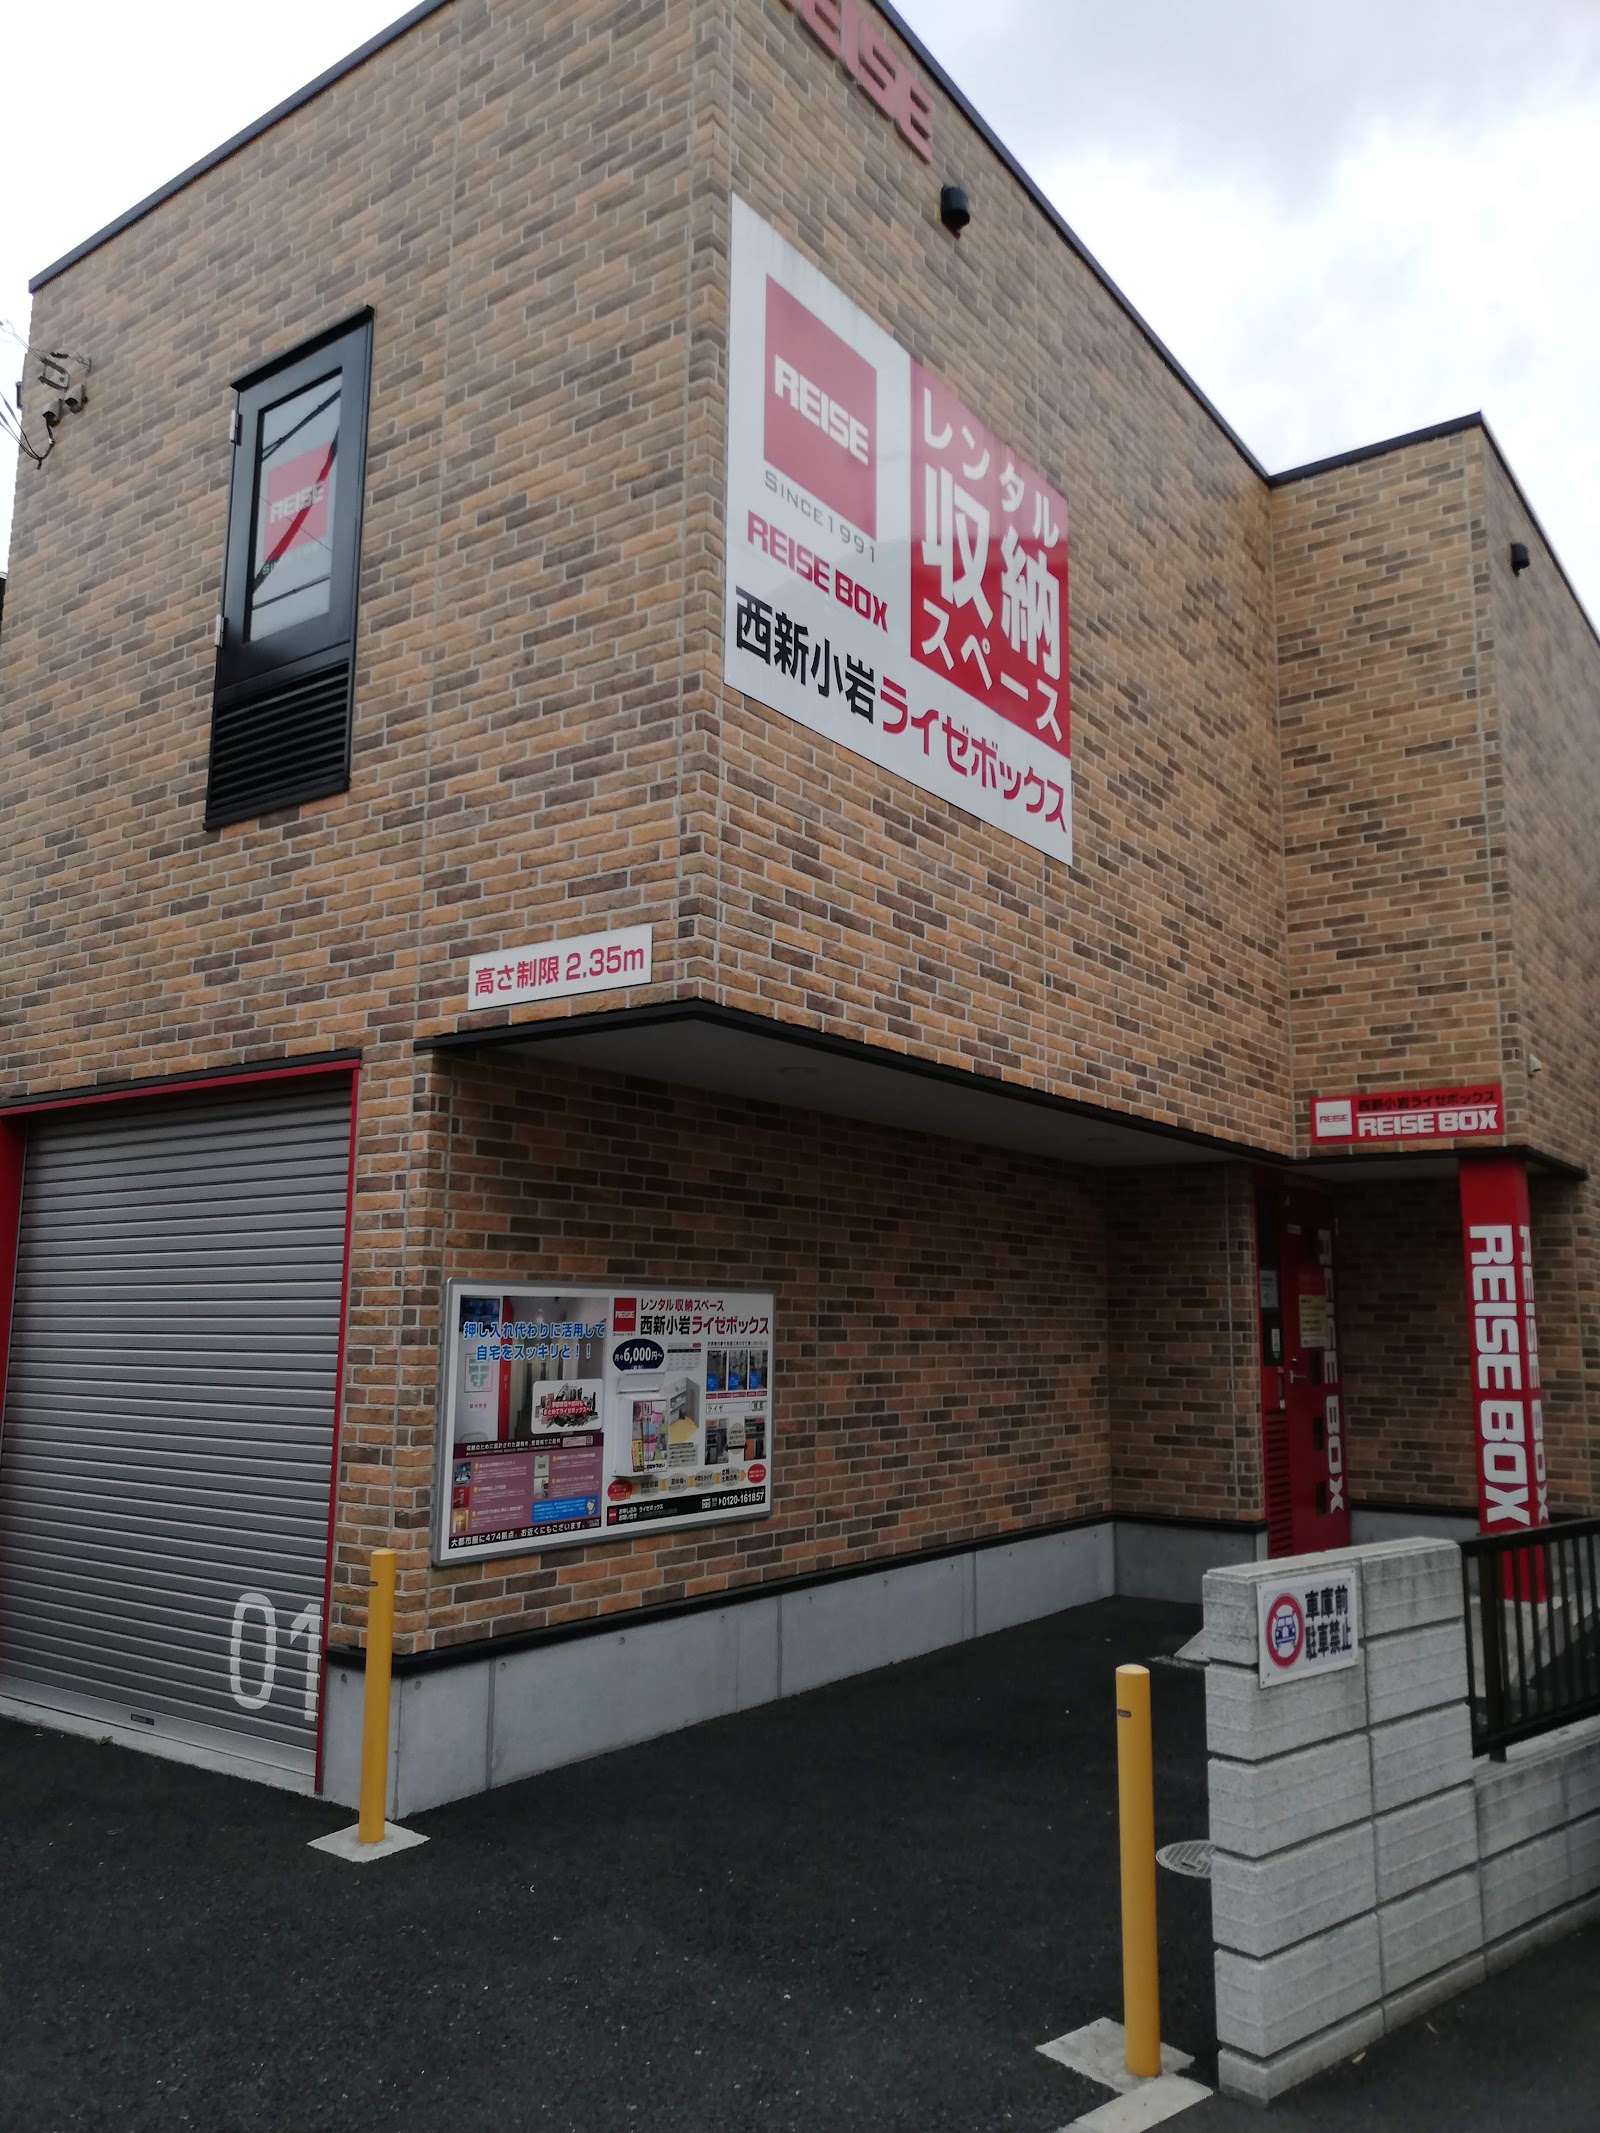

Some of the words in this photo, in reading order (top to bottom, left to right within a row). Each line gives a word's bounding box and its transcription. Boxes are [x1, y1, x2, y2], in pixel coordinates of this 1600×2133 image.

[781, 0, 932, 162] EISE
[774, 354, 869, 466] REISE
[924, 386, 1060, 548] レンタル
[747, 510, 830, 594] REISE
[835, 568, 889, 633] BOX
[921, 463, 1061, 681] 収納
[735, 585, 1067, 833] 西新小岩ライゼボックス
[921, 598, 1063, 743] スペース
[475, 955, 560, 996] 高さ制限
[566, 945, 644, 981] 2.35m
[1319, 1114, 1349, 1123] REISE
[1358, 1113, 1435, 1137] REISE
[1439, 1109, 1498, 1132] BOX
[464, 1321, 606, 1340] 押し入れ代わりに活用して
[640, 1298, 725, 1313] レンタル収納スペース
[640, 1315, 770, 1336] 西新小岩ライゼボックス
[1469, 1225, 1523, 1390] REISE
[1519, 1225, 1541, 1390] REISE
[1532, 1400, 1549, 1527] BOX
[1326, 1395, 1344, 1514] BOX
[1480, 1400, 1531, 1526] BOX
[230, 1592, 322, 1722] 01
[1305, 1584, 1349, 1622] 車庫前
[1305, 1616, 1352, 1662] 駐車禁止
